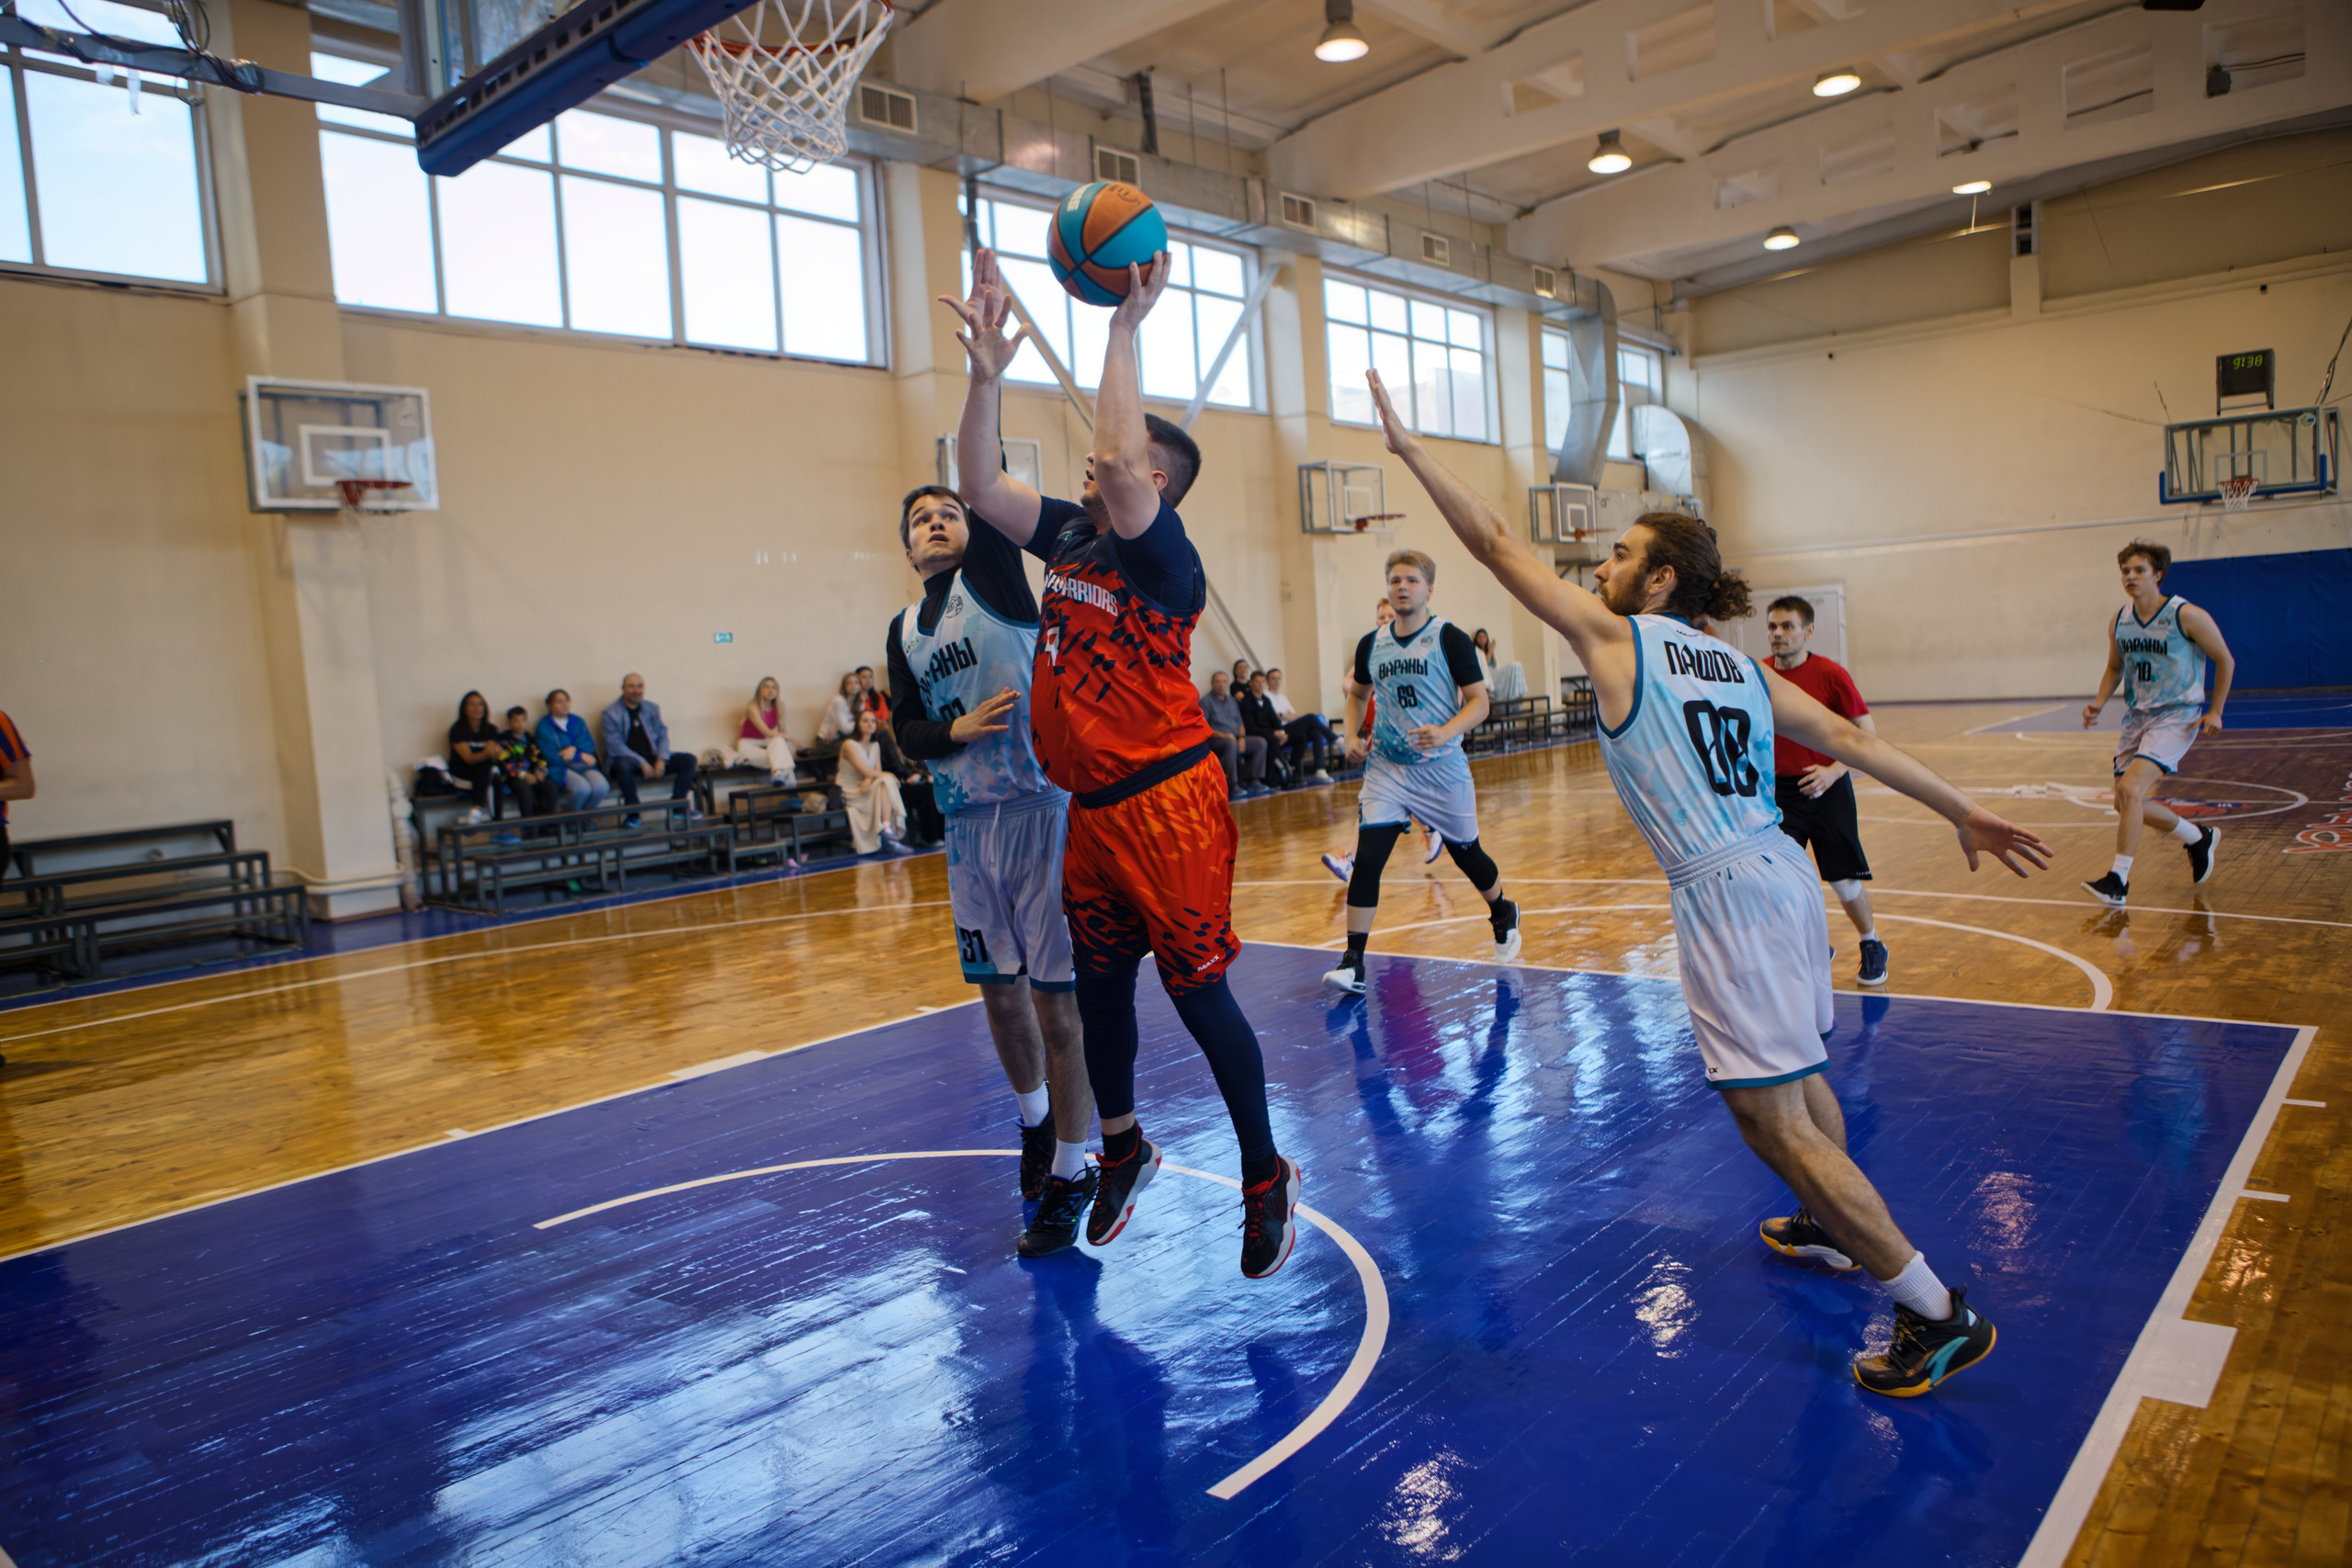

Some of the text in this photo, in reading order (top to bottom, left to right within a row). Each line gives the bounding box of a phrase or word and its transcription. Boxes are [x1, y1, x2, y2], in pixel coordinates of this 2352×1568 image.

[1378, 659, 1429, 680] ВАРАНЫ
[1664, 640, 1746, 683] ПАШОВ
[2136, 661, 2152, 682] 10
[1396, 685, 1419, 709] 69
[1682, 699, 1759, 797] 00
[959, 927, 989, 964] 31
